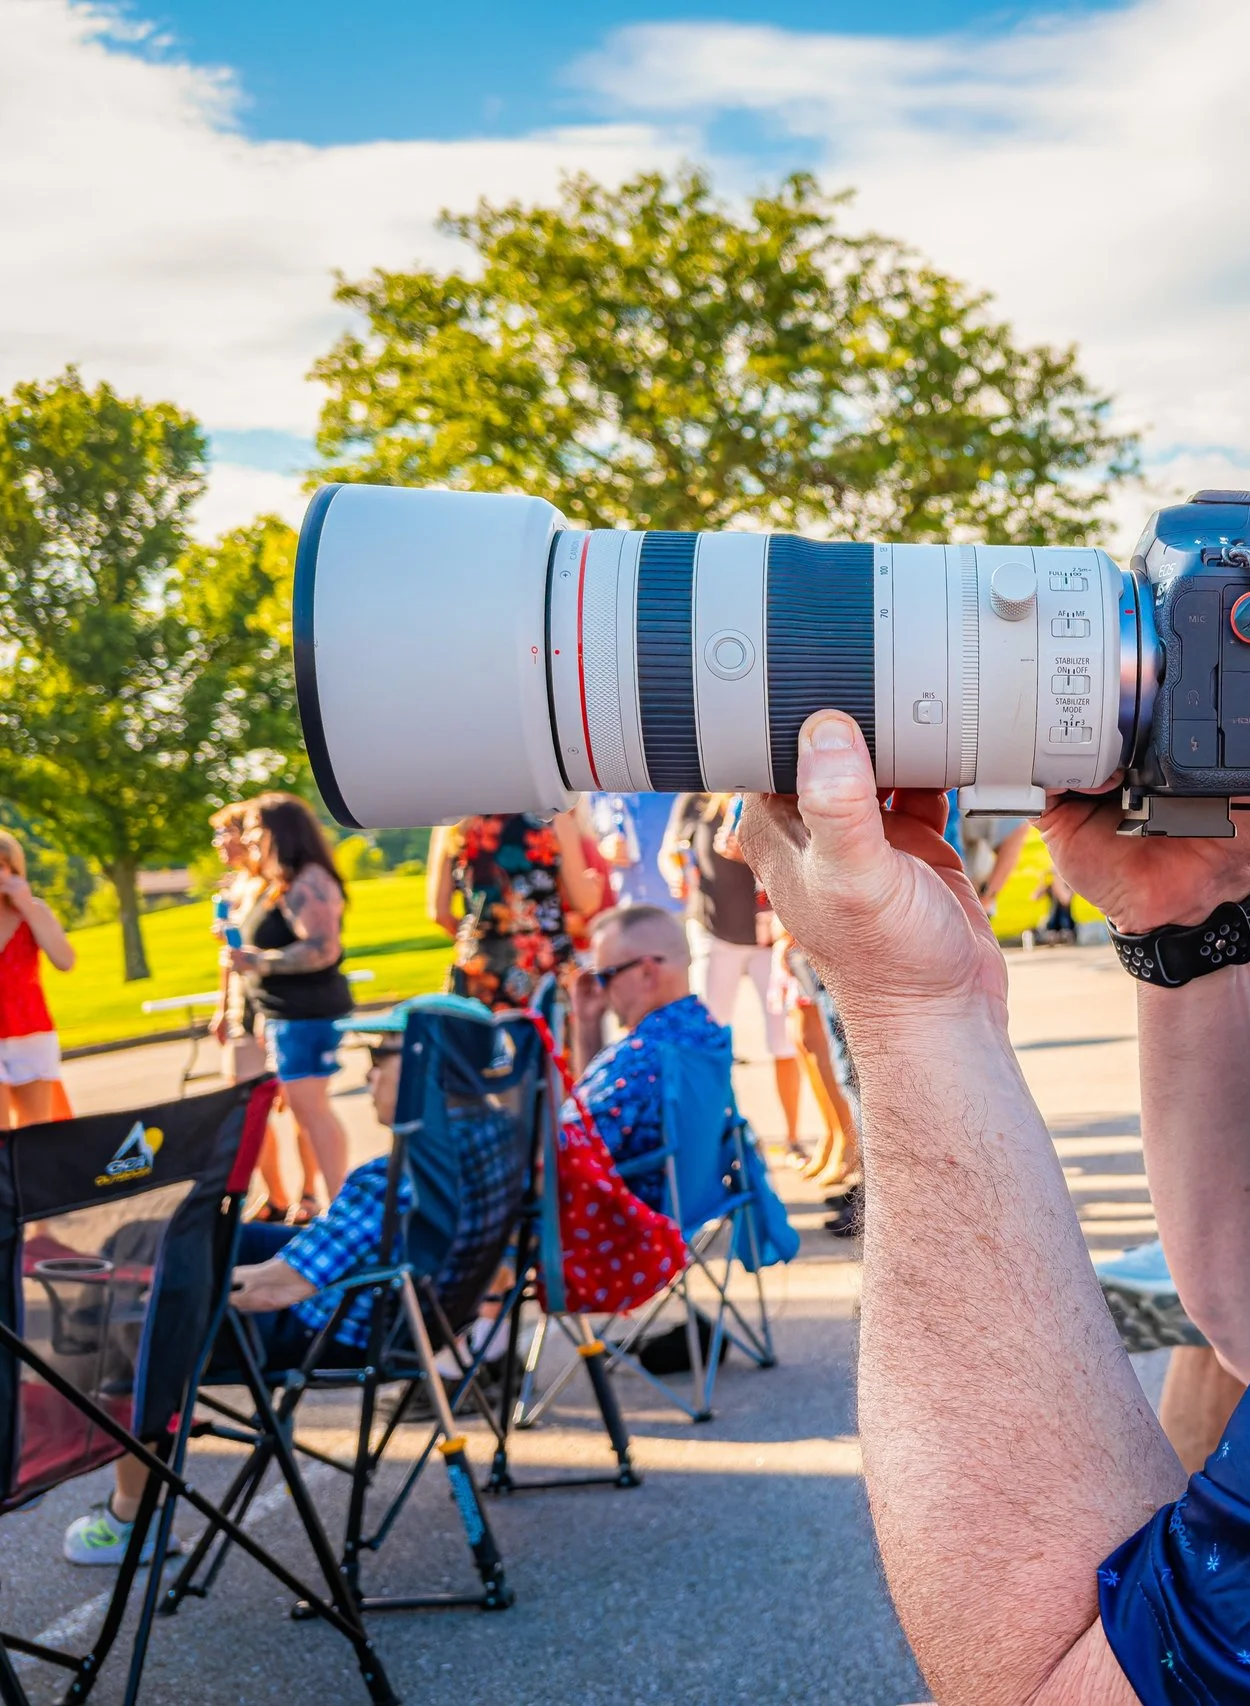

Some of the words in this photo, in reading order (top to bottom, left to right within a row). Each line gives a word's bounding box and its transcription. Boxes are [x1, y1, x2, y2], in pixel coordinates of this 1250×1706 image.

[1158, 562, 1176, 577] EOS
[880, 608, 889, 619] 70
[1188, 615, 1206, 624] MIC
[1055, 657, 1090, 665] STABILIZER
[1057, 666, 1067, 674] ON
[1076, 666, 1088, 674] OFF
[922, 691, 936, 699] IRIS
[1055, 697, 1090, 706] STABILIZER
[1062, 706, 1083, 714] MODE
